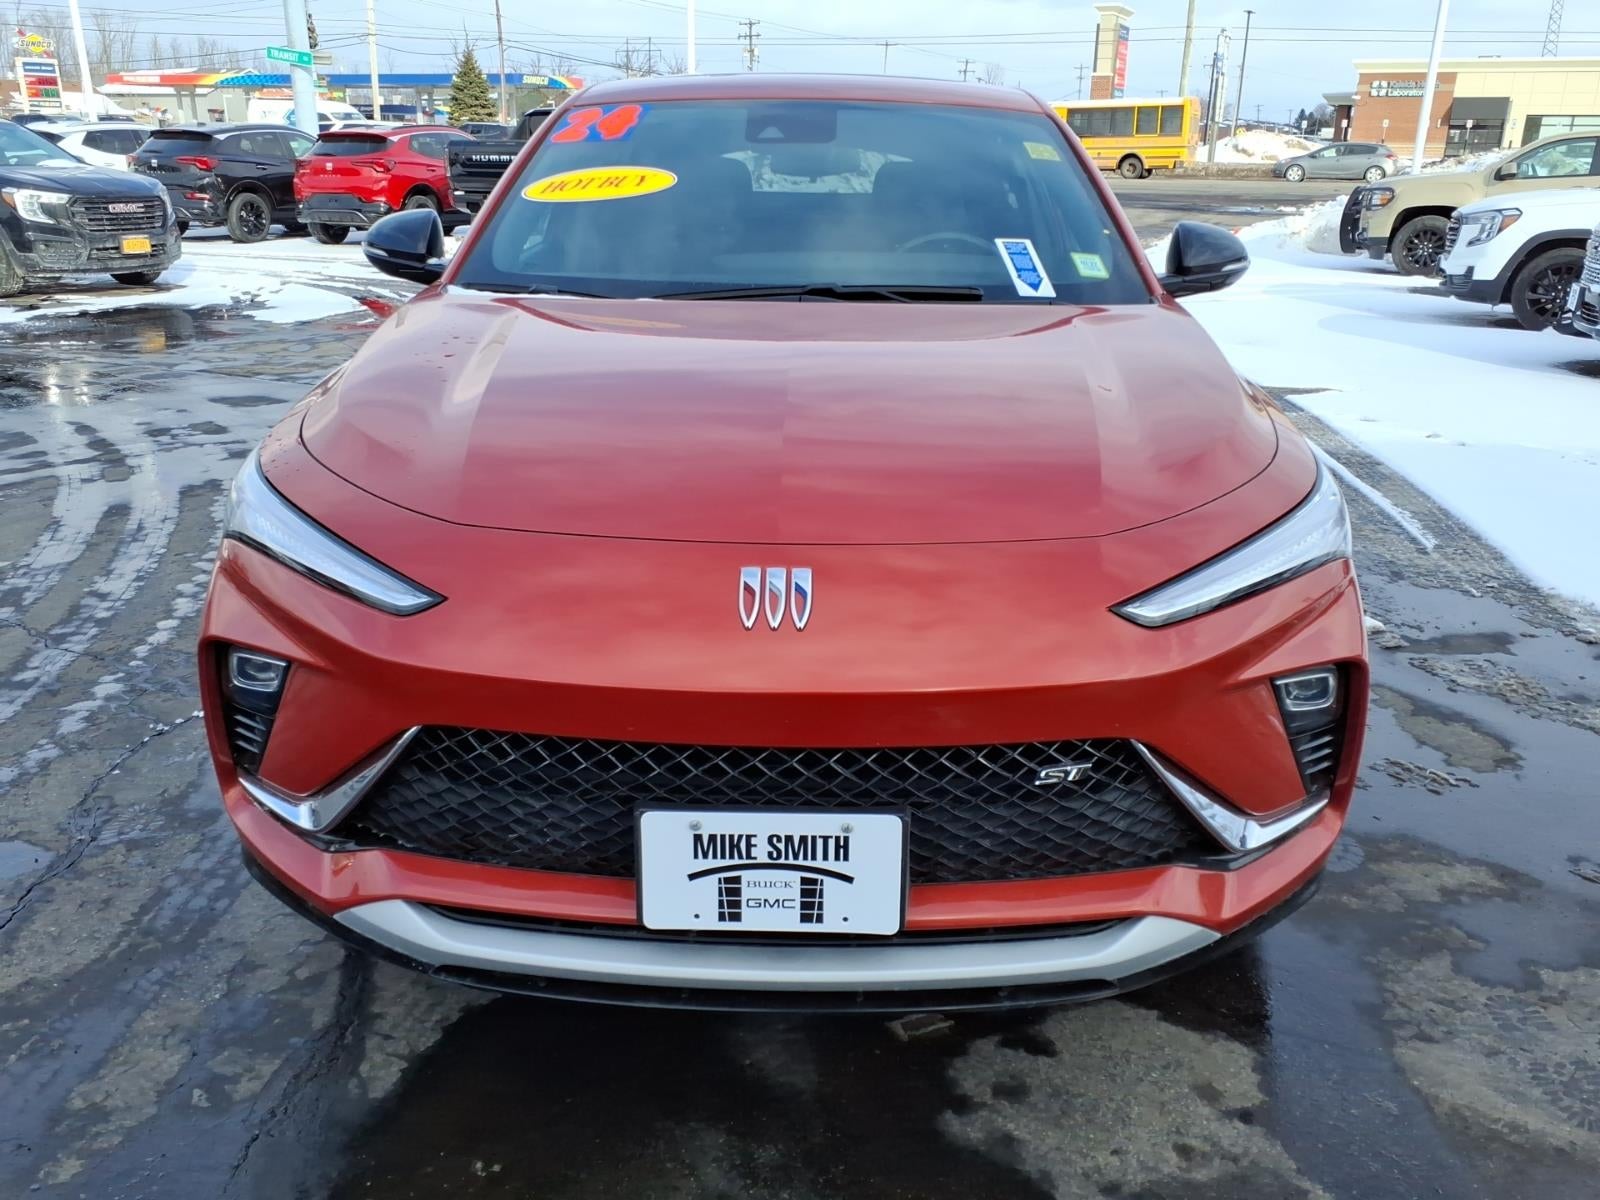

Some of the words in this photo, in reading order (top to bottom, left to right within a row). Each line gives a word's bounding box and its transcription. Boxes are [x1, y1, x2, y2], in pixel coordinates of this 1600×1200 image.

[19, 39, 52, 48] SUNOCO
[270, 49, 299, 62] TRANSIT
[523, 74, 549, 85] SUNOCO
[550, 105, 642, 143] 24
[472, 154, 516, 162] HUMM
[540, 177, 595, 194] HOT
[597, 174, 652, 189] BUY
[109, 203, 145, 213] GMC
[1034, 763, 1092, 785] ST
[693, 833, 758, 861] MIKE
[767, 834, 850, 862] SMITH
[746, 880, 795, 889] BUICK
[746, 898, 796, 909] GMC
